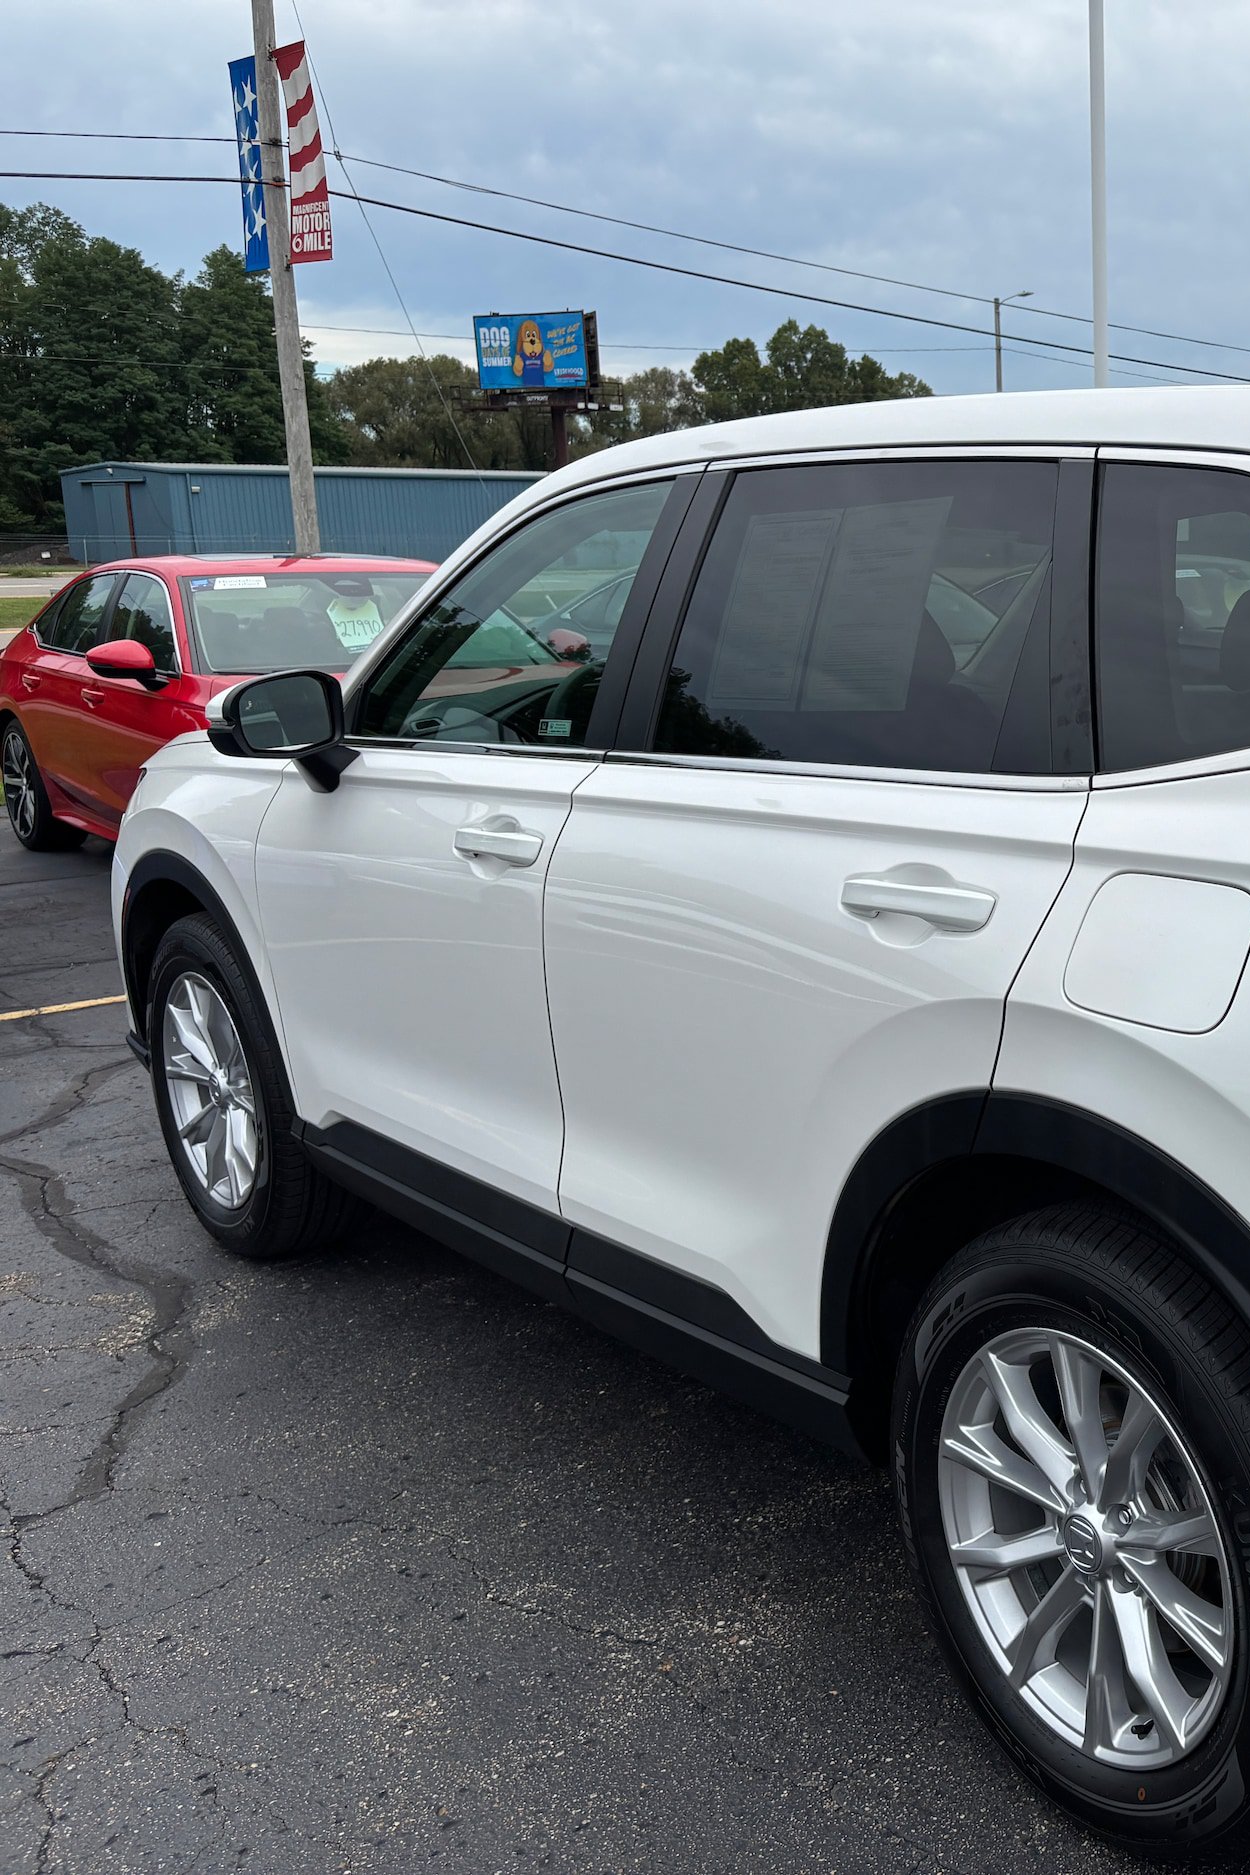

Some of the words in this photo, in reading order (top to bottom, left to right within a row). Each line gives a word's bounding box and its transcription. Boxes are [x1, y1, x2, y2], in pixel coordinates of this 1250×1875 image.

[293, 201, 329, 214] MAGNIFICENT
[292, 212, 330, 234] MOTOR
[303, 231, 332, 252] MILE
[479, 326, 510, 347] DOG
[483, 357, 512, 367] SUMMER
